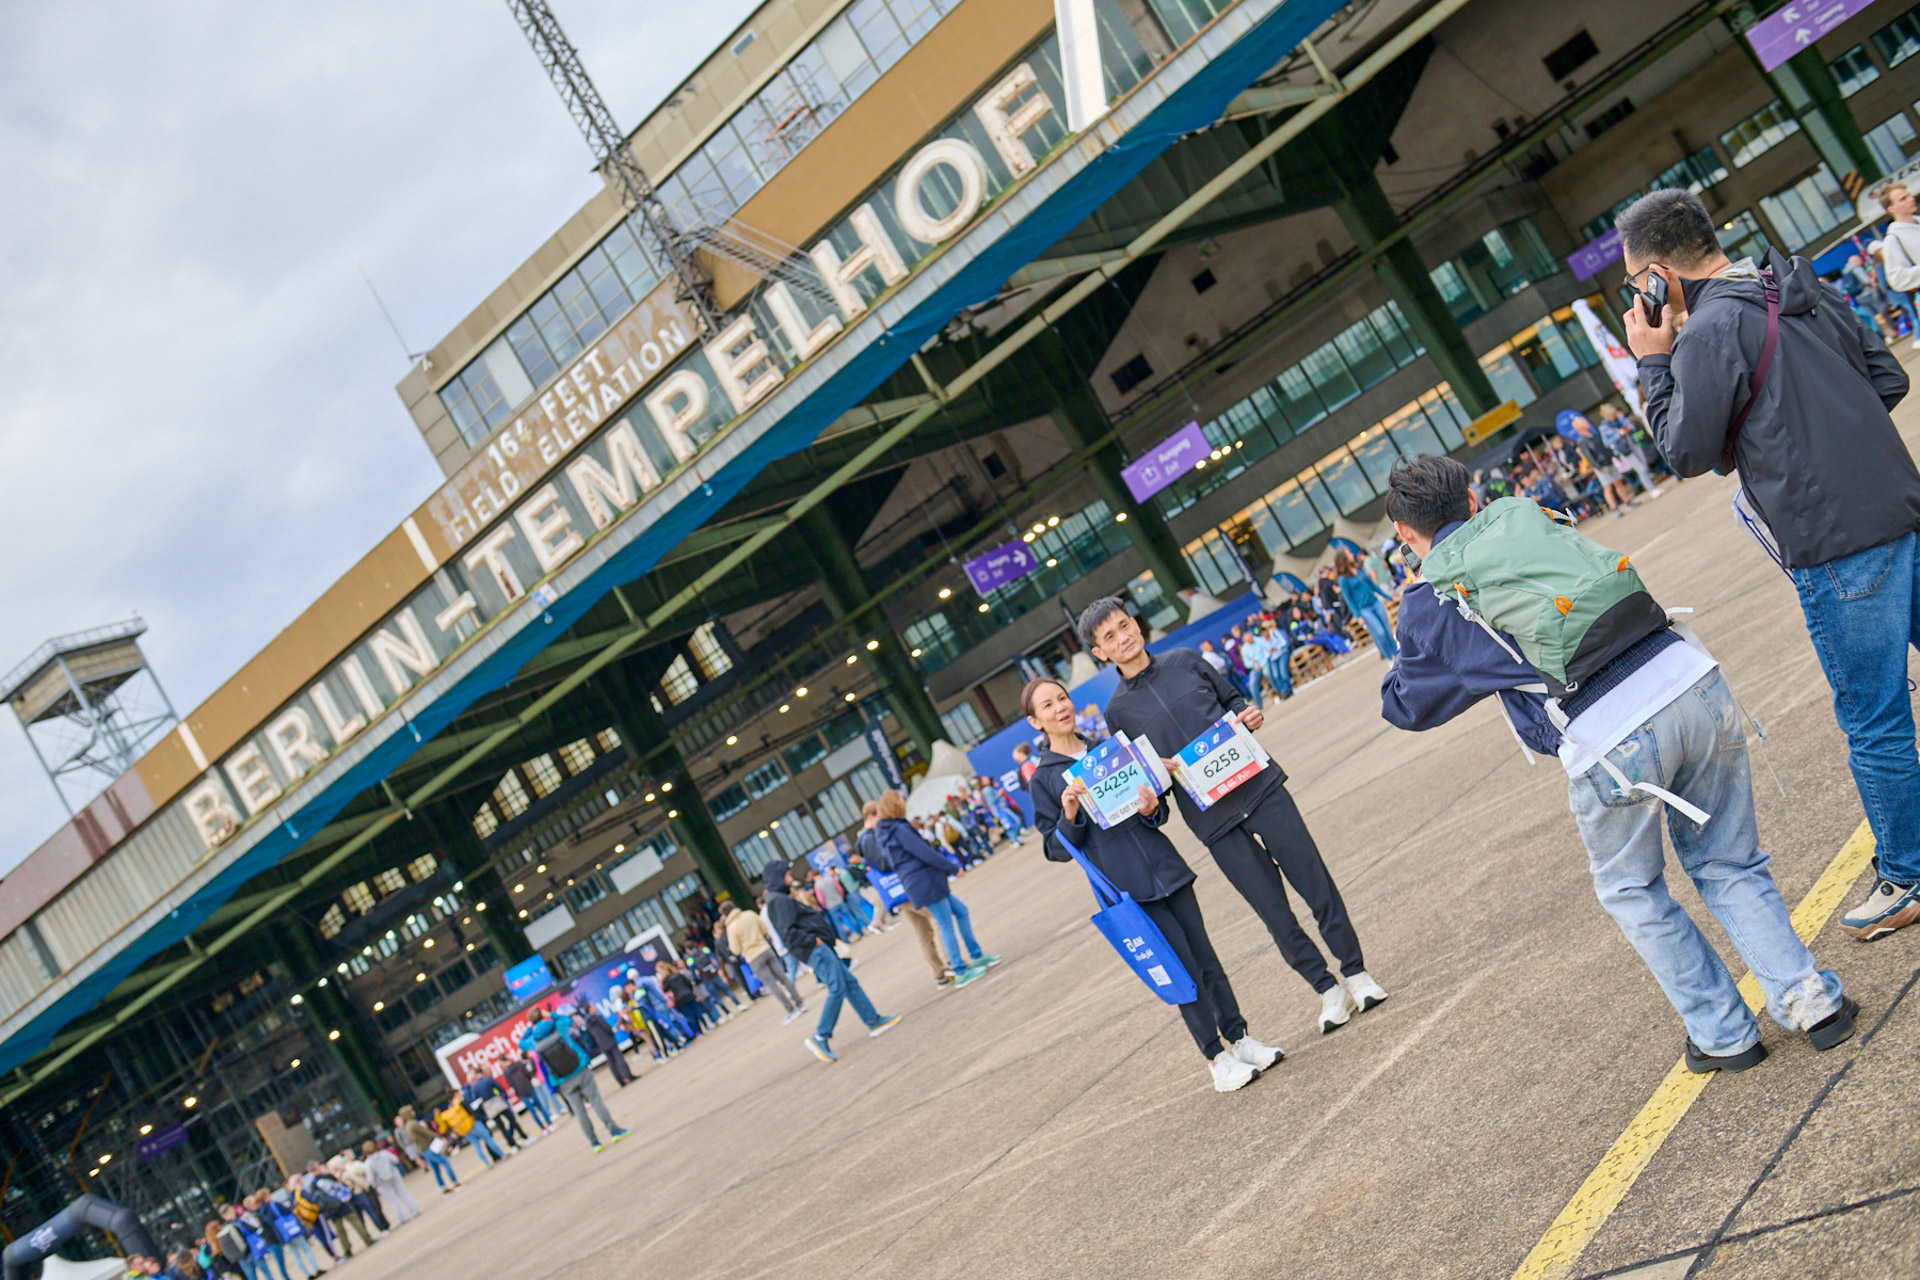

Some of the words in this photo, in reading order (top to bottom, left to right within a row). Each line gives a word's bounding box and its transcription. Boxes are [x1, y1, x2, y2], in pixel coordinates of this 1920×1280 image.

[539, 349, 606, 422] FEET
[450, 472, 520, 542] FIELD
[537, 320, 685, 464] ELEVATION
[1093, 765, 1138, 798] 34294
[1203, 748, 1240, 778] 6258
[1108, 812, 1120, 822] YOU
[1120, 804, 1131, 815] GOT
[457, 1031, 515, 1072] Hoch
